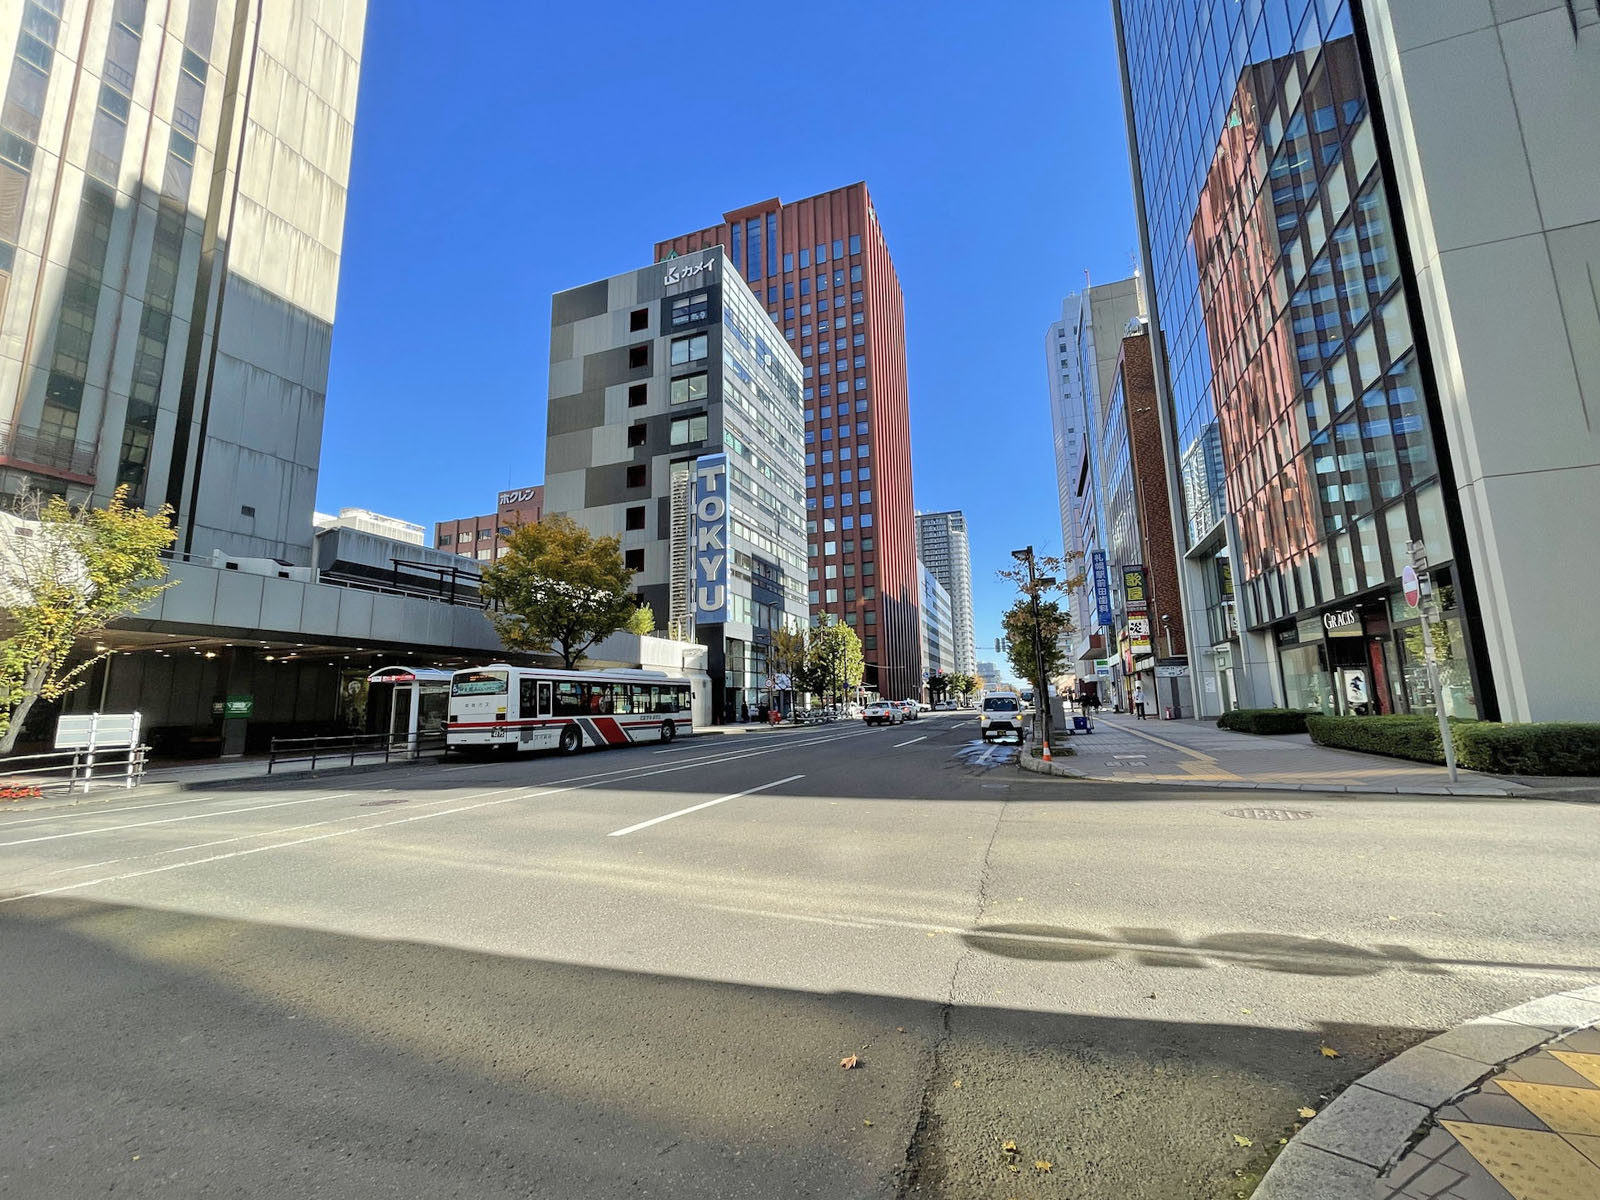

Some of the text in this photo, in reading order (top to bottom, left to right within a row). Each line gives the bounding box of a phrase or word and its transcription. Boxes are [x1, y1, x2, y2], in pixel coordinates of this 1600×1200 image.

[681, 258, 715, 278] カメイ
[500, 490, 535, 505] ホクレン
[697, 464, 725, 612] TOKYU
